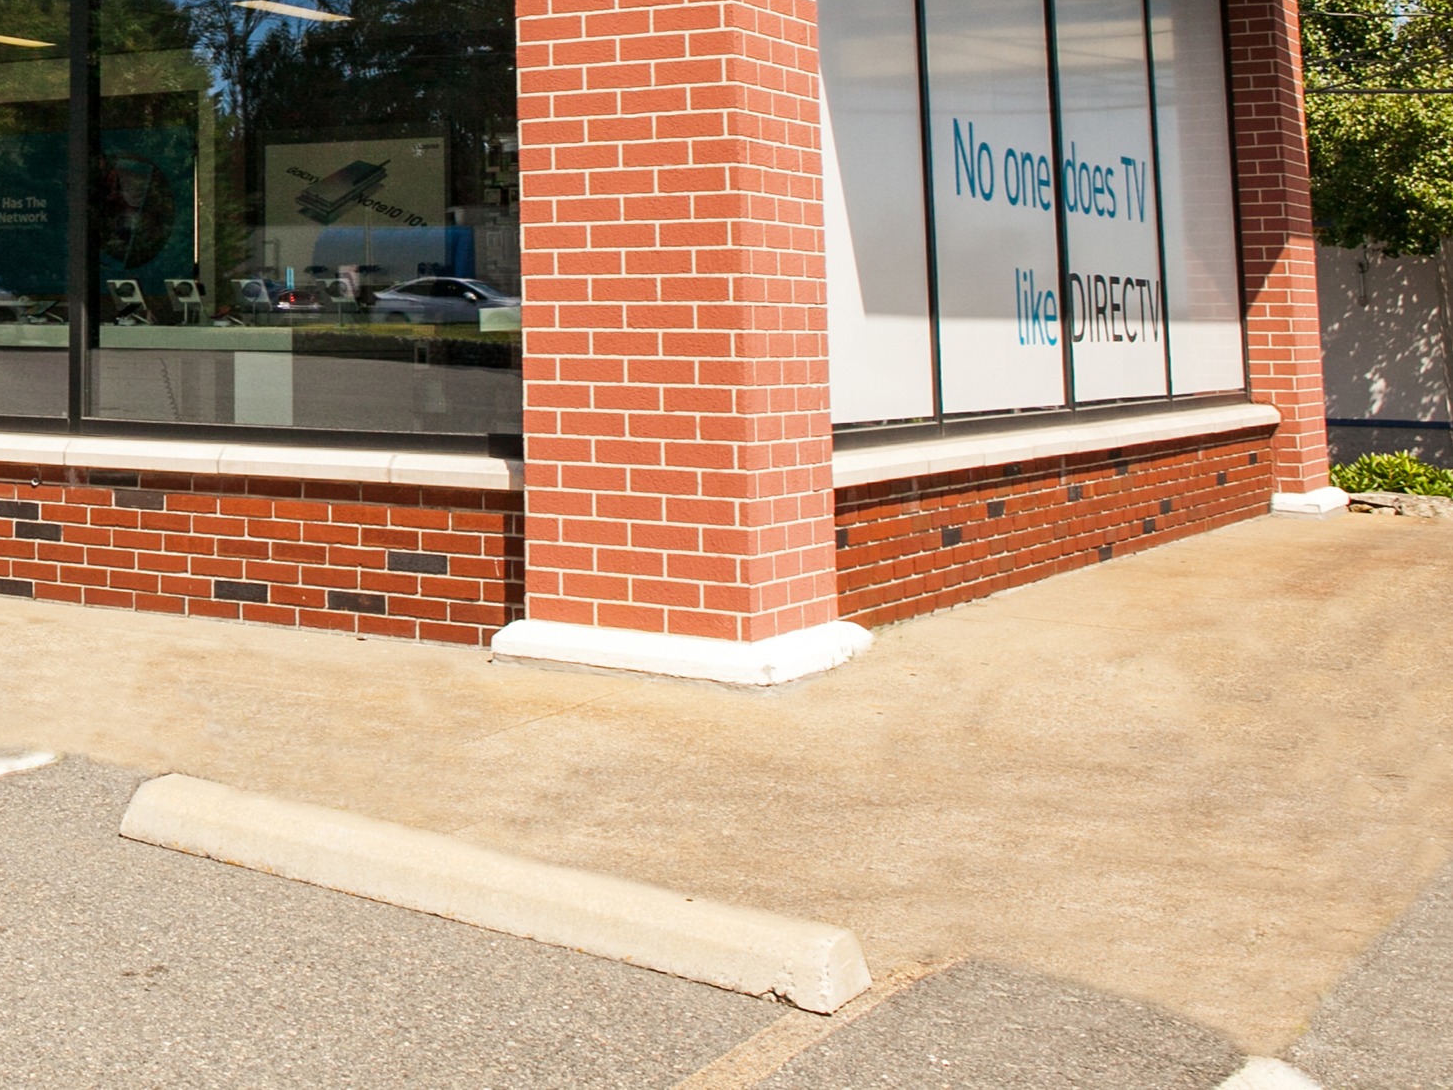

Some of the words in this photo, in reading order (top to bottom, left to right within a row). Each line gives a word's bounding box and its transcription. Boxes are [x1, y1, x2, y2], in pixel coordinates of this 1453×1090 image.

[286, 167, 319, 184] Galaxy
[953, 118, 994, 201] No
[1004, 147, 1051, 211] one
[1063, 141, 1116, 219] does
[1120, 156, 1146, 224] TV
[2, 197, 23, 209] Has
[25, 195, 47, 208] The
[1014, 267, 1058, 346] like
[1068, 272, 1159, 343] DIRECTV
